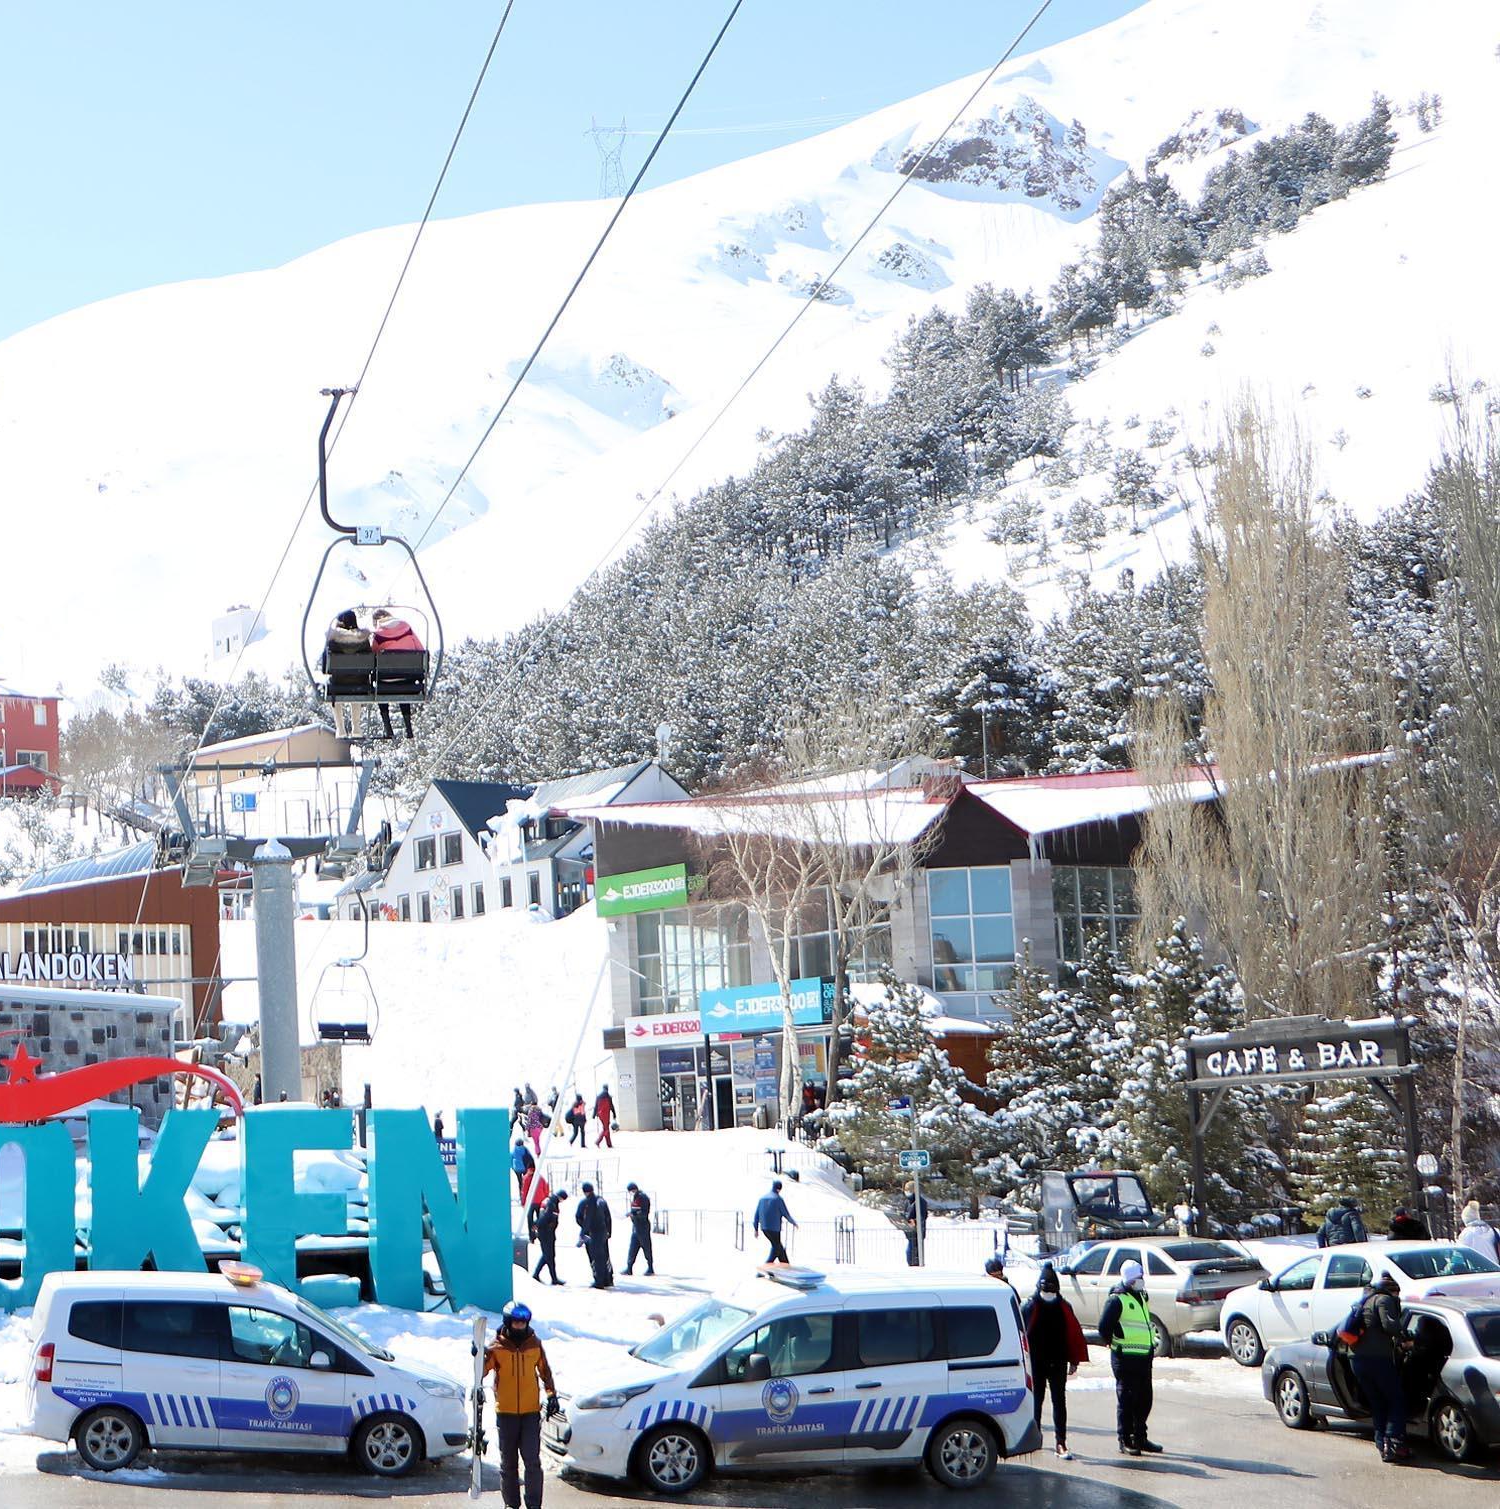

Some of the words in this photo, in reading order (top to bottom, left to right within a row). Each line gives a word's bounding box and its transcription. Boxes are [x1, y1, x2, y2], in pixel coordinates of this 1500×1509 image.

[364, 529, 373, 539] 37
[735, 992, 806, 1016] EJDER300
[652, 1019, 701, 1036] EJDER320
[1206, 1045, 1277, 1076] CAFE
[1288, 1048, 1306, 1071] &
[1317, 1039, 1382, 1069] BAR
[249, 1418, 276, 1428] TRAFİK
[277, 1420, 312, 1431] ZABITASI
[755, 1424, 786, 1435] TRAFİK
[787, 1423, 825, 1433] ZABITASI
